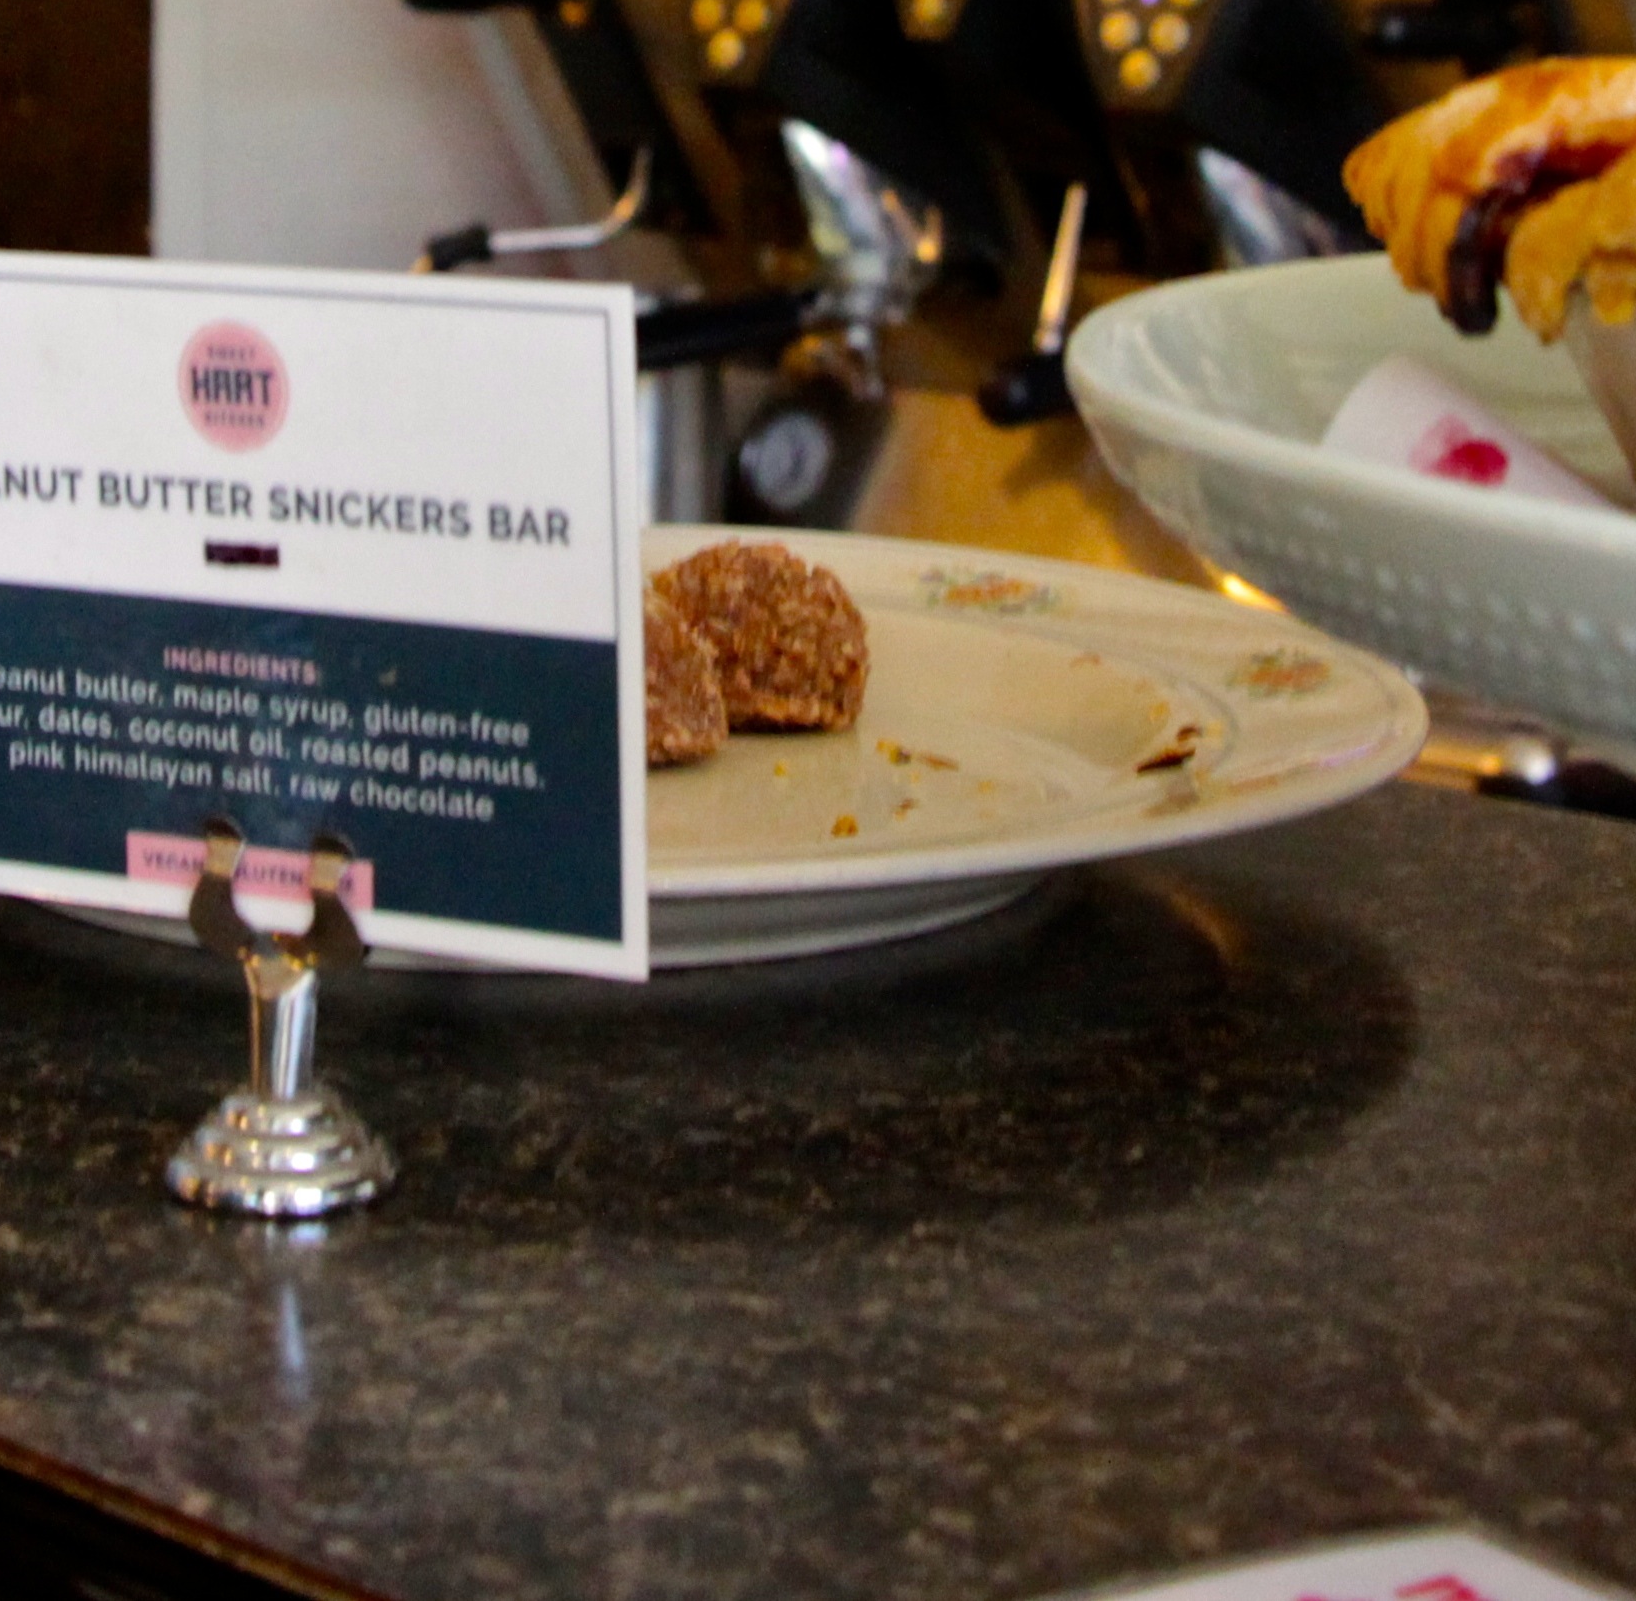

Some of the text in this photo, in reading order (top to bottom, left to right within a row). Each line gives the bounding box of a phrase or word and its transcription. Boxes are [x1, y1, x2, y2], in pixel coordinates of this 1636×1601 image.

[191, 365, 273, 408] HART
[98, 470, 252, 518] BUTTER
[268, 484, 472, 537] SNICKERS
[487, 502, 569, 546] BAR
[38, 702, 118, 739] dates,
[129, 716, 239, 753] coconut
[248, 728, 290, 761] oil,
[301, 736, 409, 774] roasted
[76, 668, 162, 707] butter,
[173, 683, 260, 718] maple
[269, 697, 353, 731] syrup,
[364, 702, 529, 747] gluten-free
[9, 739, 495, 822] pink himalayan salt, raw chocolate
